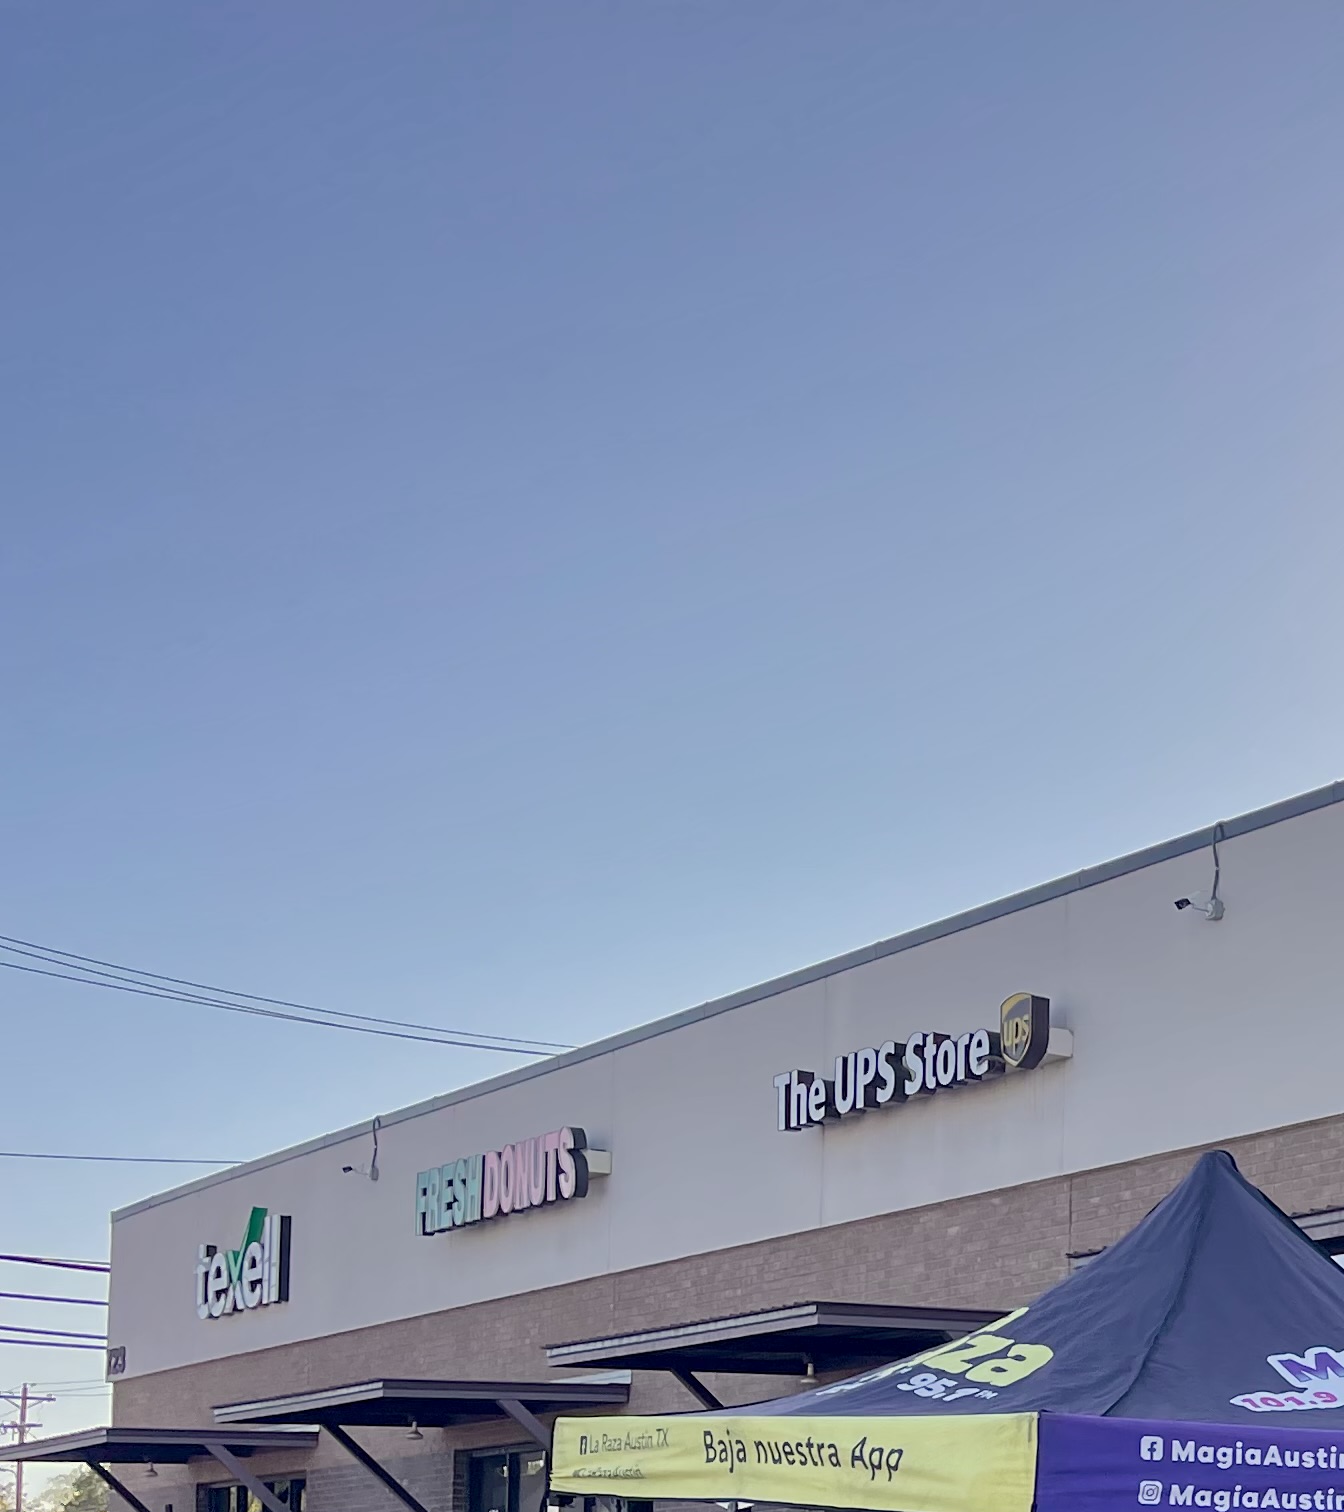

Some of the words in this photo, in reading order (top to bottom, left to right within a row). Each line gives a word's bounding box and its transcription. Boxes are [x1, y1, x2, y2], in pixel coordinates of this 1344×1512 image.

[1003, 1014, 1030, 1056] ups
[773, 1069, 826, 1131] The
[834, 1040, 896, 1115] UPS
[904, 1029, 990, 1096] Store
[415, 1154, 482, 1236] FRESH
[483, 1126, 580, 1219] DONUTS
[194, 1206, 284, 1320] texell
[1242, 1391, 1338, 1410] 101.9
[589, 1434, 600, 1454] La
[602, 1433, 622, 1453] Raza
[623, 1430, 653, 1452] Austin
[656, 1427, 670, 1449] TX
[703, 1430, 747, 1474] Baja
[755, 1436, 842, 1469] nuestra
[851, 1436, 905, 1482] App
